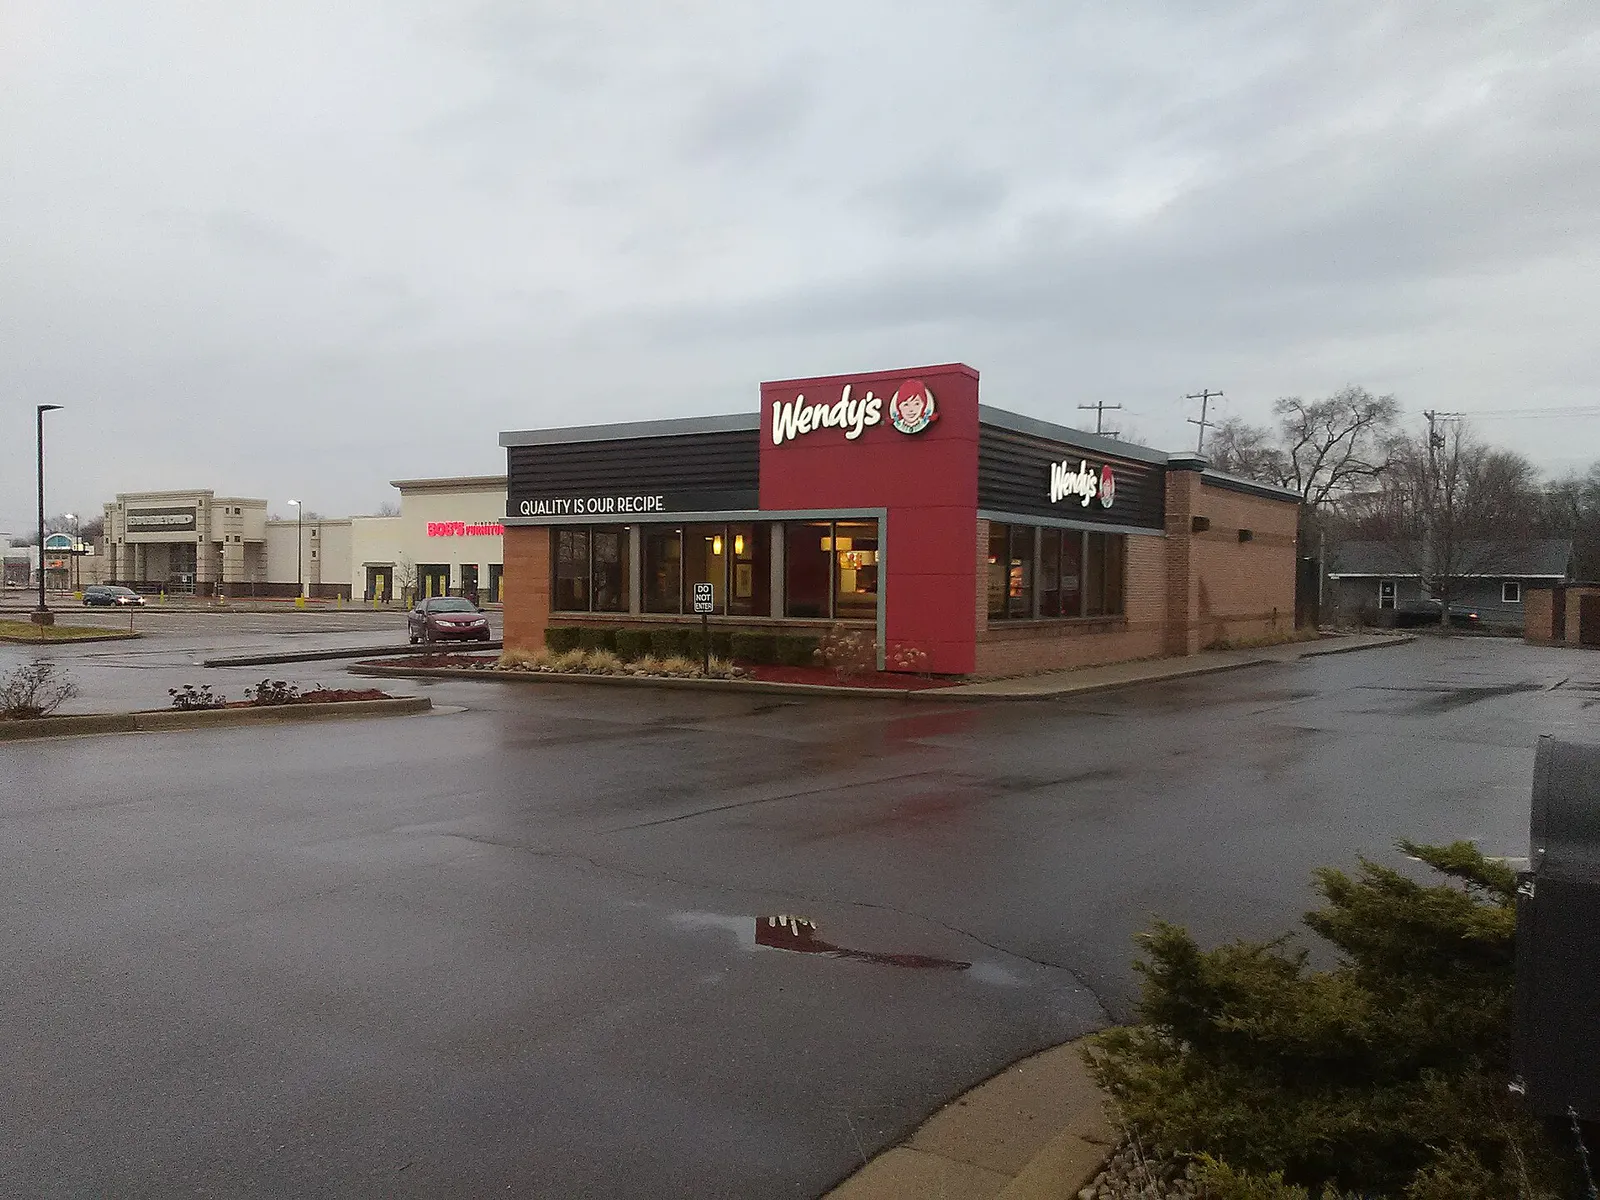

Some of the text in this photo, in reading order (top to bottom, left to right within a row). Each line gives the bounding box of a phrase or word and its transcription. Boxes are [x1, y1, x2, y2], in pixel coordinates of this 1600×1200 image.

[772, 384, 882, 445] Wendy's
[1050, 460, 1098, 507] Wendy's
[520, 500, 571, 515] QUALITY
[573, 498, 584, 513] IS
[587, 497, 614, 513] OUR
[426, 521, 465, 537] BOB'S
[697, 585, 709, 593] DO
[695, 594, 711, 602] NOT
[695, 602, 712, 610] ENTER
